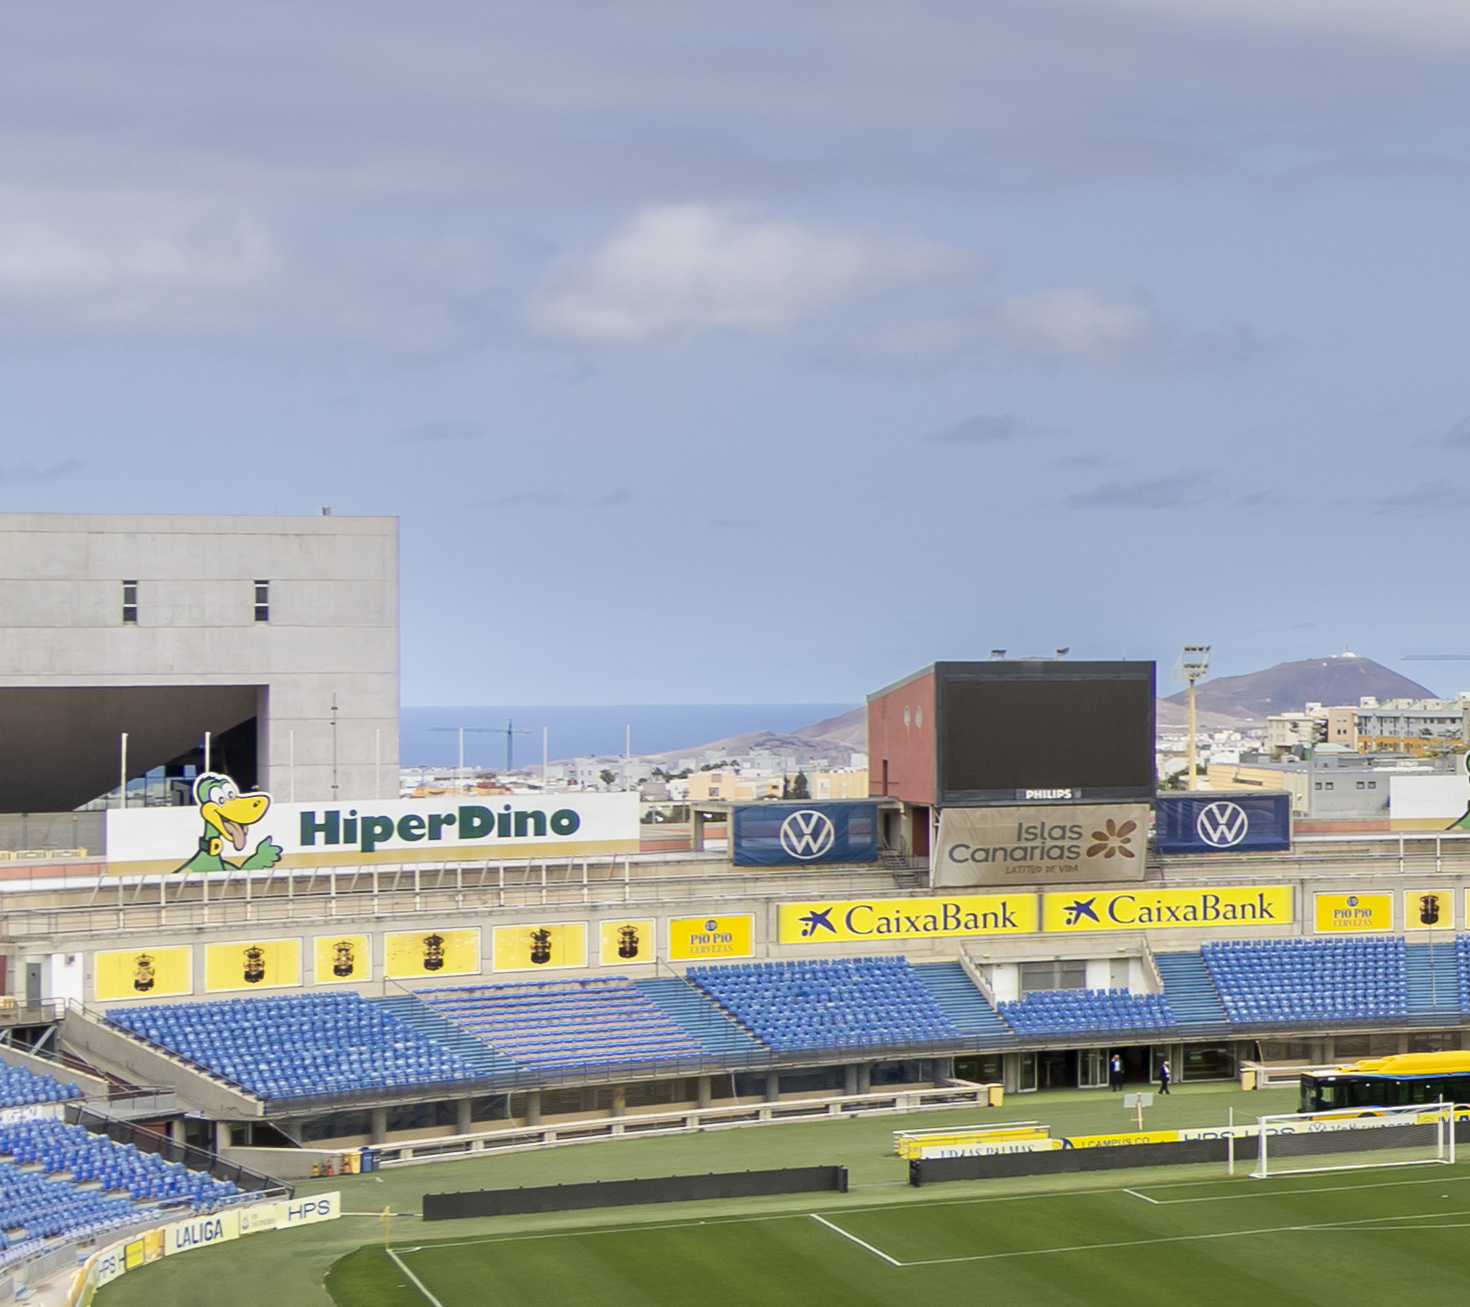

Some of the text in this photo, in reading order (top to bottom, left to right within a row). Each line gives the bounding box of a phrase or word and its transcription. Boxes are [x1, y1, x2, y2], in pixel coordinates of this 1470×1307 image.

[1026, 789, 1072, 800] PHILIPS
[301, 804, 581, 853] HiperDino
[1016, 820, 1083, 842] Islas
[949, 843, 1082, 864] Canarias
[1046, 865, 1057, 875] DE
[1060, 864, 1079, 875] VIDA
[844, 901, 1019, 936] CaixaBank
[1107, 893, 1276, 925] CaixaBank
[289, 1199, 331, 1221] HPS
[175, 1217, 224, 1251] LALIGA
